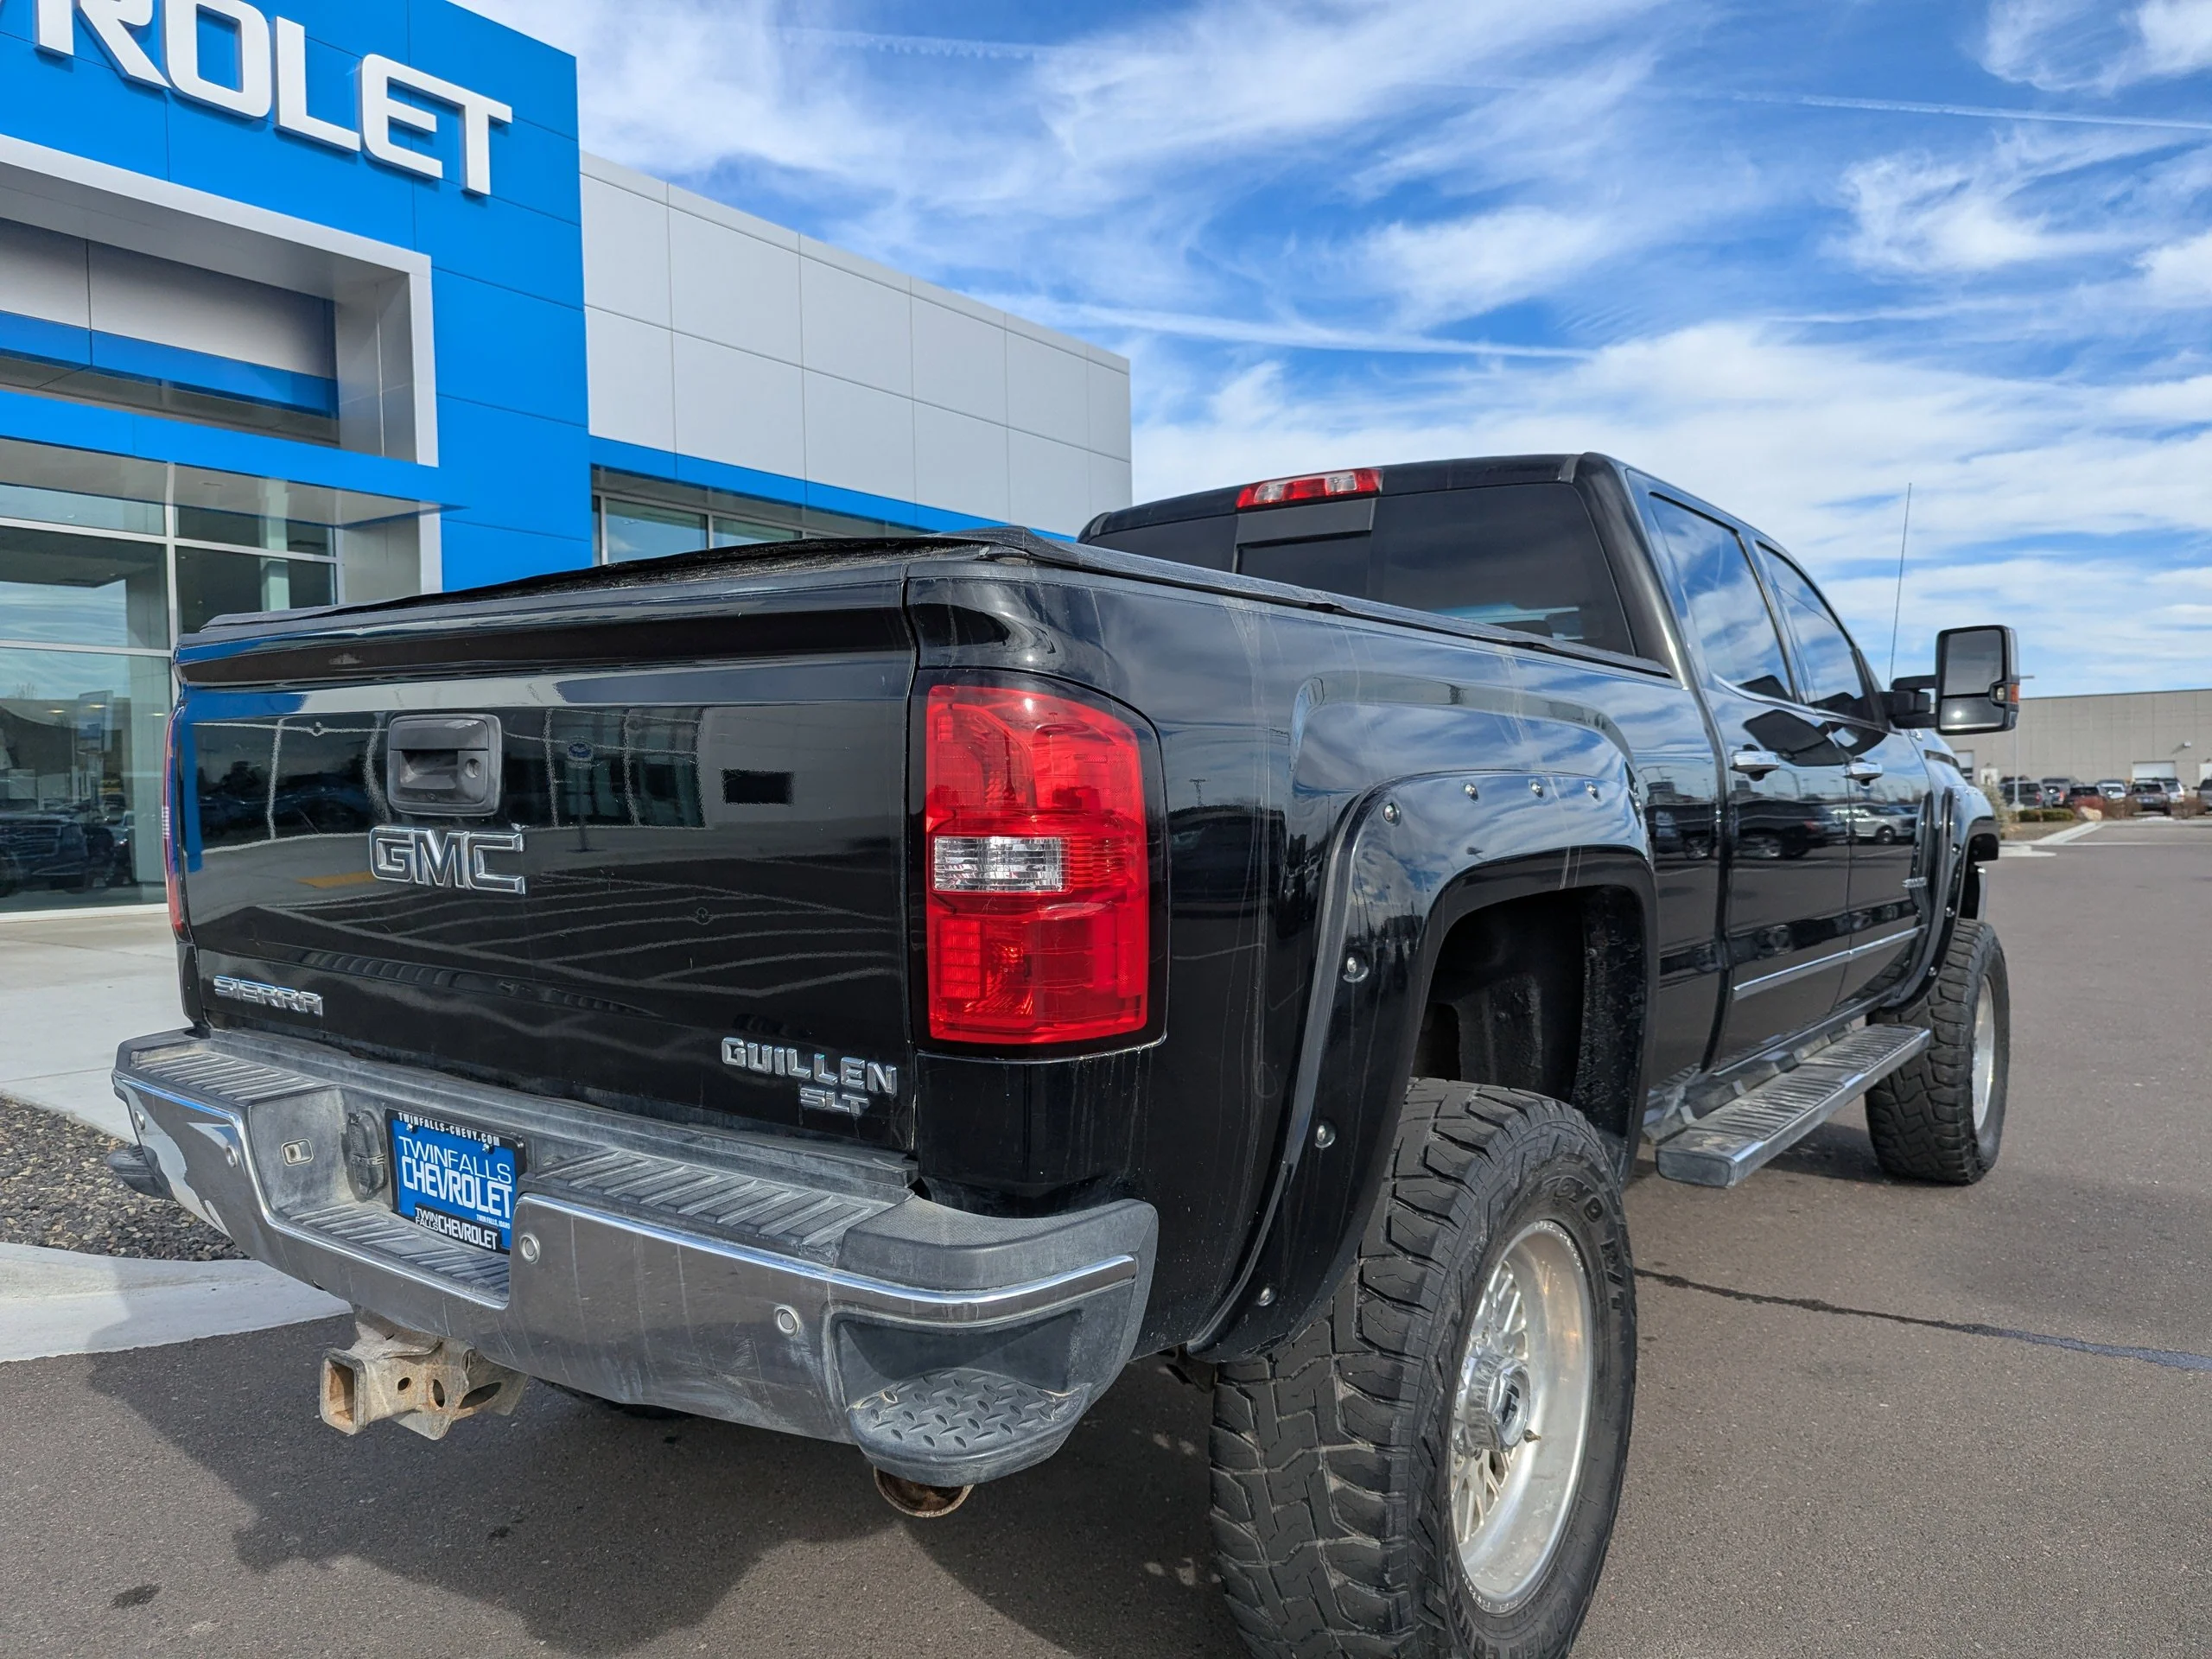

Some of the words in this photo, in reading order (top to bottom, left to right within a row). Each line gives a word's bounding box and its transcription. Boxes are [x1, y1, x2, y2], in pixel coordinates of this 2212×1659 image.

[369, 825, 526, 895] GMC
[213, 976, 323, 1017] SIERRA
[721, 1036, 898, 1096] GUILLEN
[799, 1087, 870, 1116] SLT
[397, 1111, 500, 1147] TWINFALLS-CHEVY.COM
[401, 1155, 513, 1219] CHEVROLET
[415, 1206, 438, 1224] TWIN
[415, 1216, 439, 1232] FALLS
[438, 1214, 499, 1251] CHEVROLET
